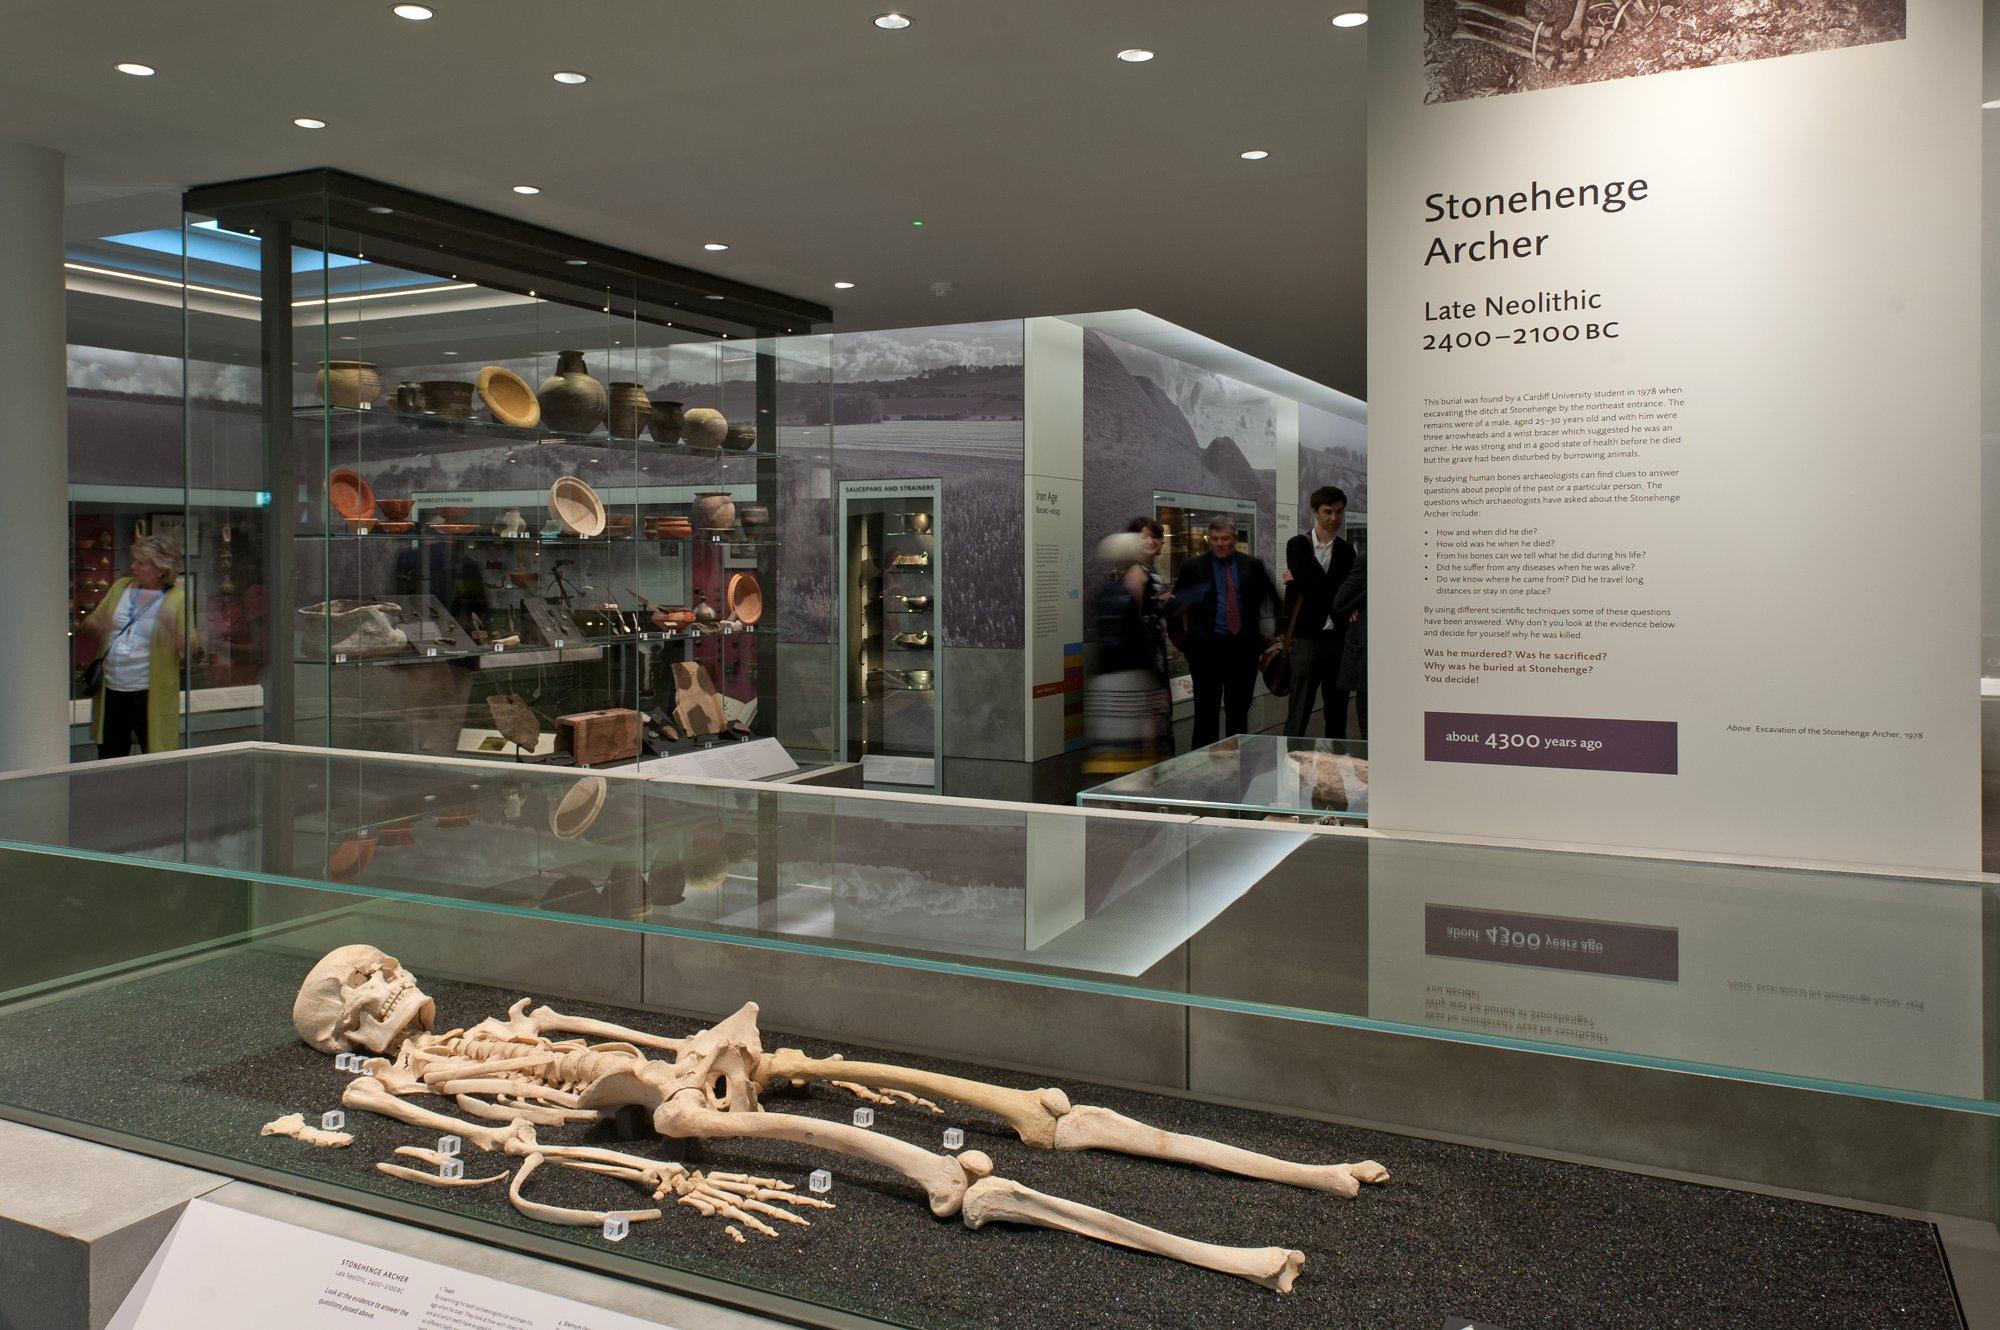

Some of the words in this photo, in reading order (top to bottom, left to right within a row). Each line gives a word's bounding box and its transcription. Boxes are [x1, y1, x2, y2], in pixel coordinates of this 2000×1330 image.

[1425, 179, 1648, 222] Stonehenge
[1424, 231, 1549, 266] Archer
[1425, 302, 1476, 320] Late
[1486, 290, 1602, 316] Neolithic
[1036, 491, 1046, 501] Iron
[1048, 492, 1057, 505] Age
[1470, 551, 1493, 559] bones
[1524, 551, 1536, 559] tell
[1586, 551, 1613, 560] during
[1437, 575, 1448, 583] Do
[1462, 575, 1484, 583] know
[1626, 576, 1644, 585] long
[1483, 587, 1498, 596] stay
[1500, 587, 1507, 595] in
[1526, 588, 1551, 596] place?
[1424, 605, 1434, 614] By
[1436, 606, 1456, 615] using
[1491, 606, 1525, 614] scientific
[1527, 606, 1570, 616] techniques
[1630, 607, 1671, 617] questions
[1424, 617, 1442, 625] have
[1506, 618, 1524, 627] Why
[1526, 618, 1548, 626] don't
[1549, 620, 1564, 628] you
[1594, 619, 1608, 627] the
[1610, 619, 1647, 627] evidence
[1467, 629, 1477, 637] for
[1479, 630, 1511, 639] yourself
[1512, 630, 1528, 639] why
[1530, 630, 1540, 638] he
[1424, 648, 1444, 656] Was
[1447, 648, 1458, 657] he
[1461, 649, 1512, 658] murdered?
[1515, 650, 1536, 658] Was
[1539, 650, 1551, 659] he
[1554, 651, 1607, 660] sacrificed?
[1424, 661, 1445, 672] Why
[1469, 662, 1480, 670] he
[1483, 662, 1514, 671] buried
[1517, 663, 1526, 672] at
[1530, 664, 1593, 675] Stonehenge?
[1424, 674, 1442, 682] You
[1445, 674, 1478, 684] decide!
[1756, 726, 1796, 734] Excavation
[1823, 728, 1870, 738] Stonehenge
[1446, 731, 1479, 742] about
[1485, 733, 1540, 749] 4300
[1544, 738, 1577, 748] years
[1580, 740, 1602, 751] ago
[812, 1179, 821, 1189] 12
[335, 1269, 346, 1277] Late
[341, 1259, 382, 1276] STONEHENGE
[383, 1271, 409, 1283] ARCHER
[325, 1287, 337, 1295] Look
[344, 1291, 352, 1300] the
[352, 1295, 375, 1306] evidence
[381, 1304, 399, 1313] answer
[400, 1308, 409, 1316] the
[319, 1299, 342, 1310] questions
[342, 1305, 359, 1314] posed
[358, 1309, 375, 1319] above.
